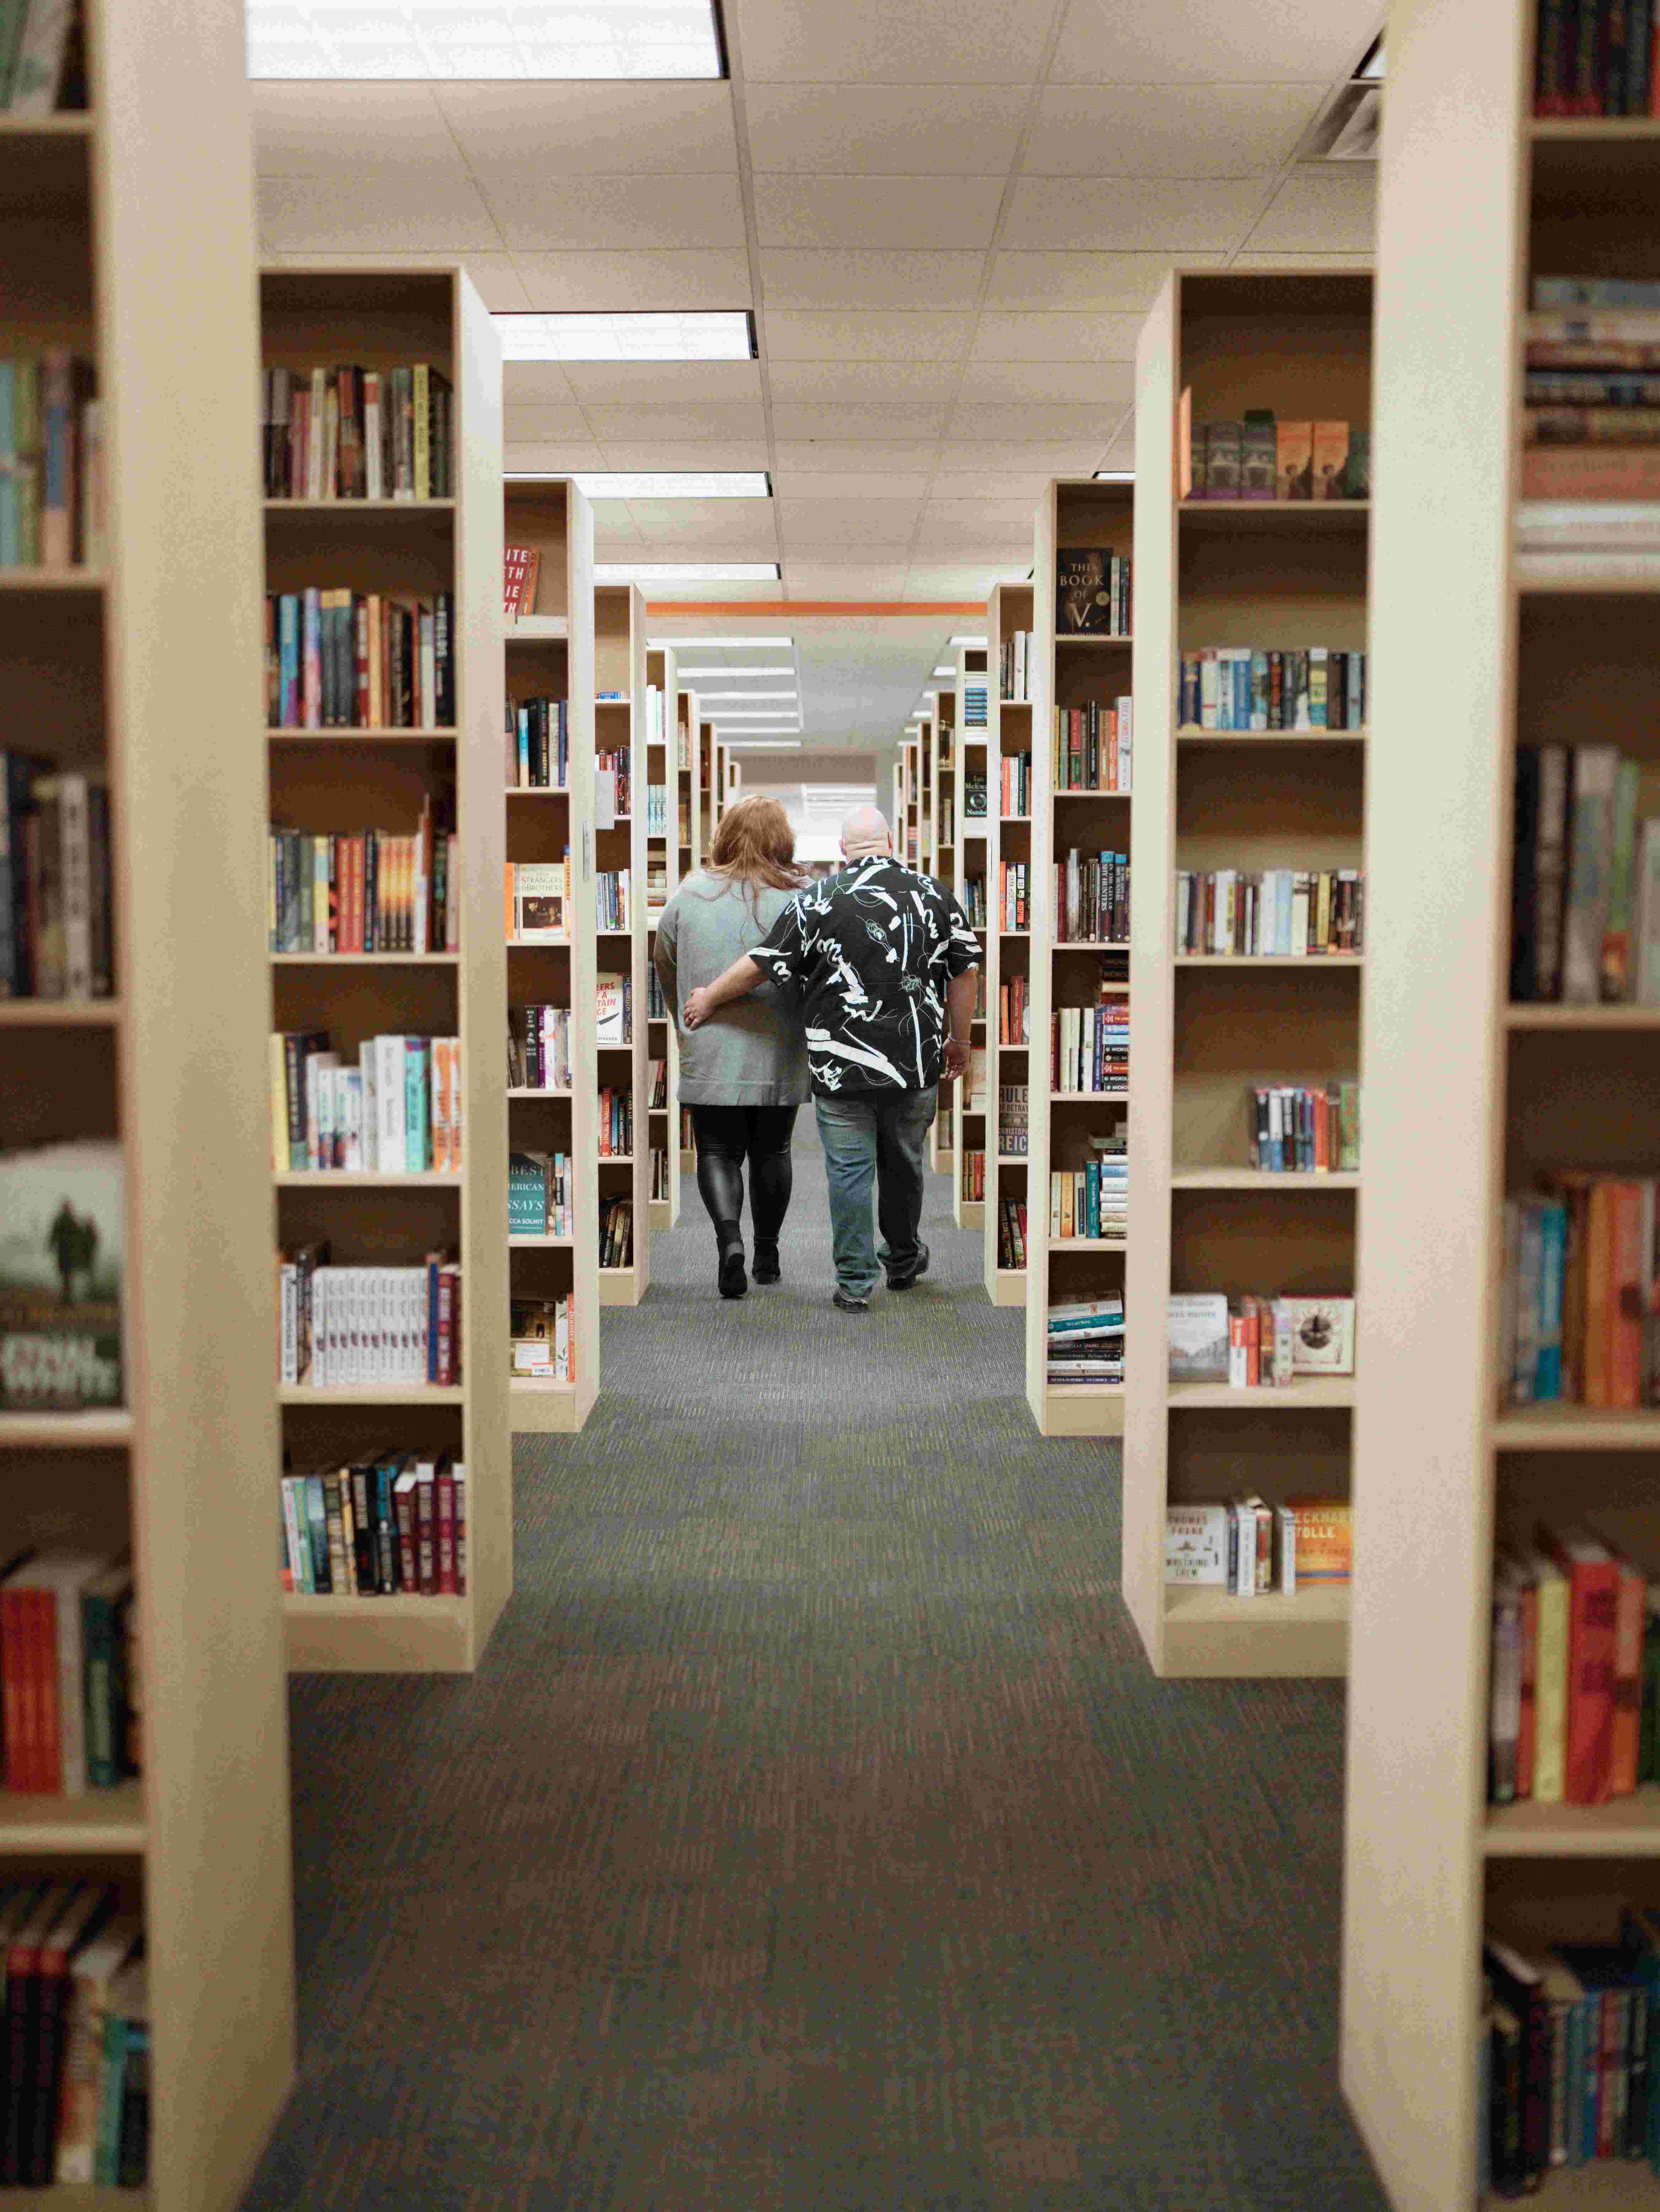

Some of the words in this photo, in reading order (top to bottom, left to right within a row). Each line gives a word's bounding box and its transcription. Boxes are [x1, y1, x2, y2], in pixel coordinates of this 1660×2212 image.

[1071, 563, 1092, 572] THE
[1060, 574, 1104, 586] BOOK
[1074, 588, 1089, 598] OF
[1068, 603, 1092, 628] V.
[1006, 1104, 1028, 1112] BETRAY
